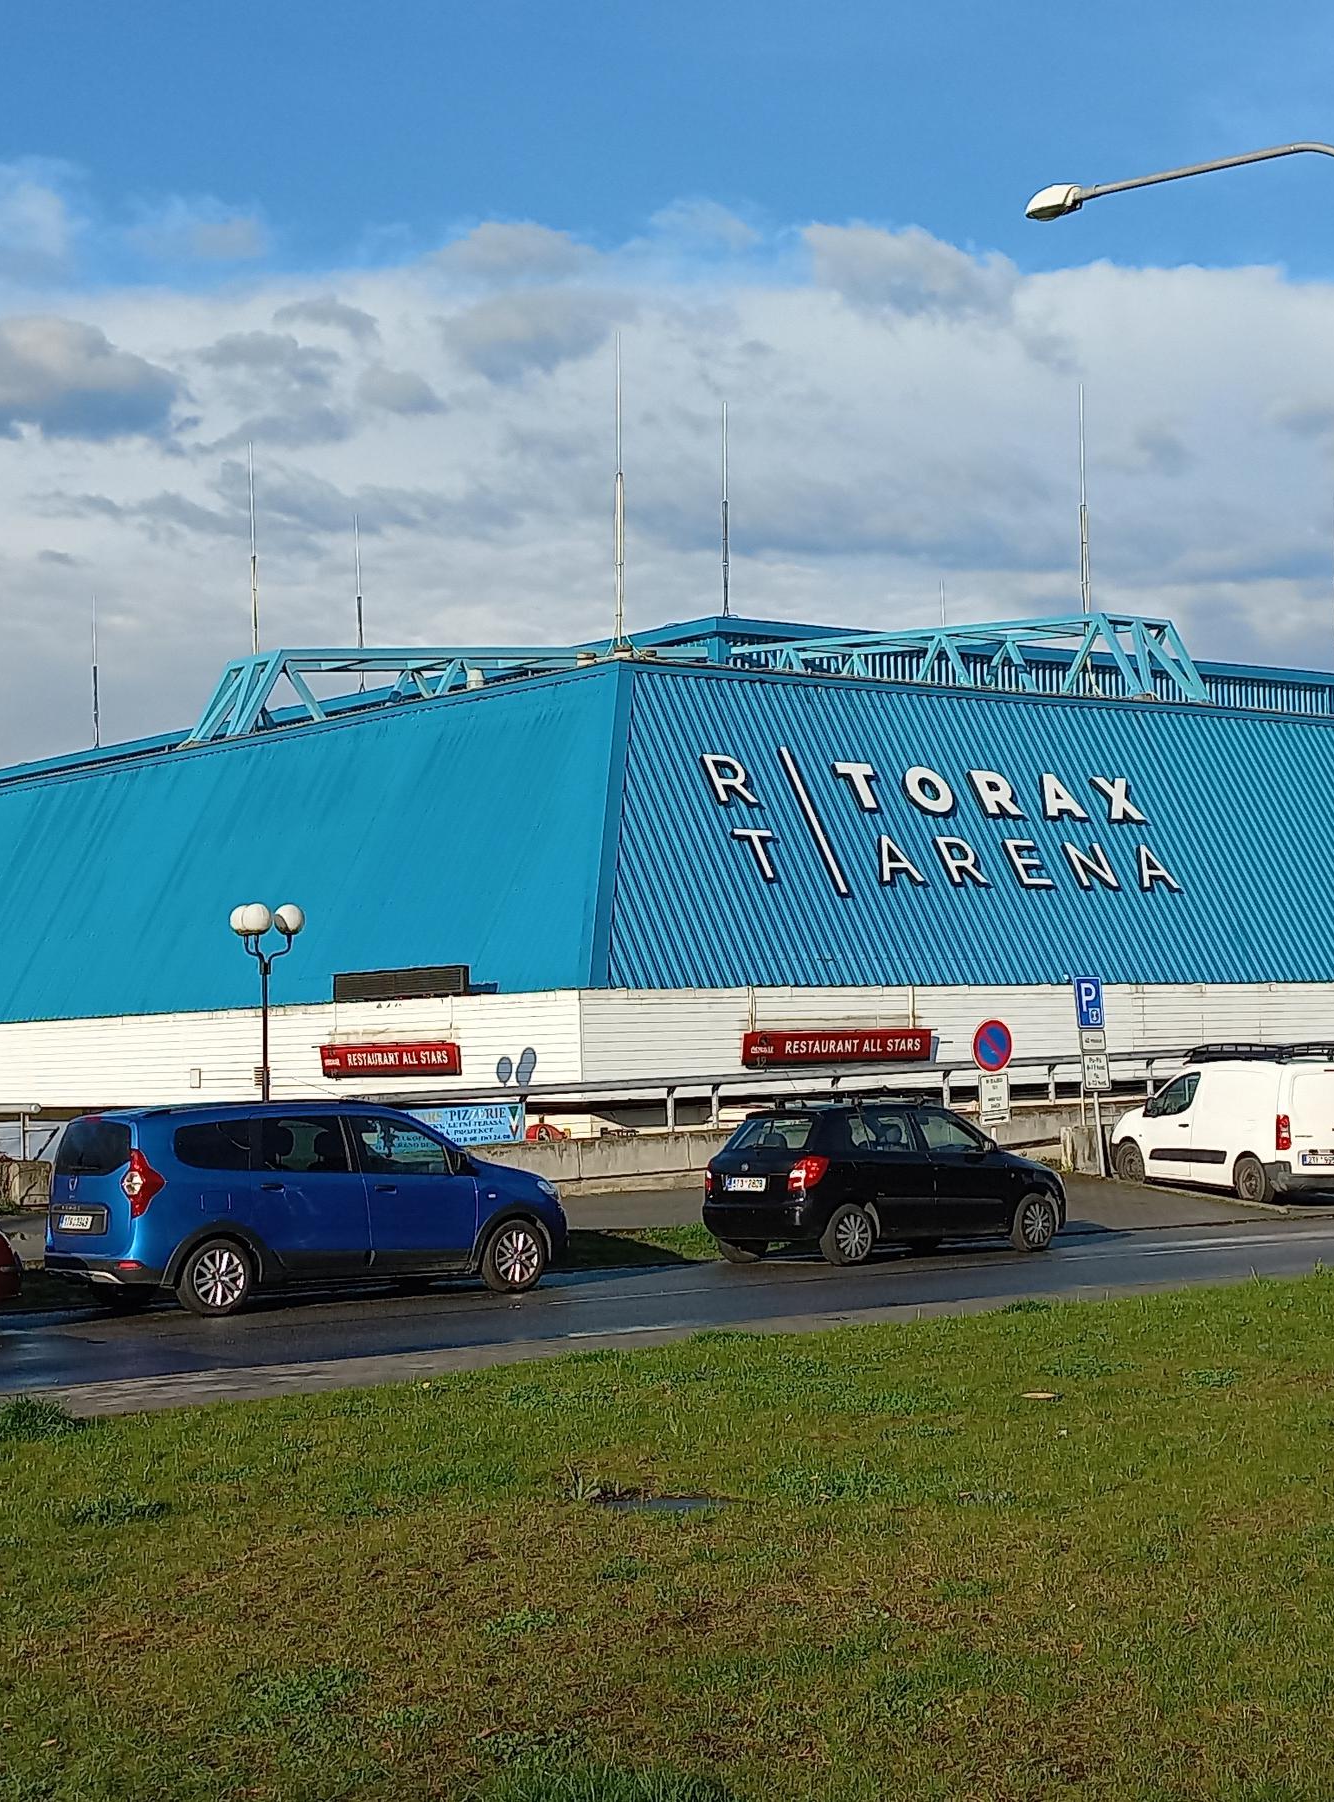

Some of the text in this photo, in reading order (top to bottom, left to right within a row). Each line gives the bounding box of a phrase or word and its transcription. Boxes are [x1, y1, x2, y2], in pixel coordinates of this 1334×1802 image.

[700, 752, 1150, 826] R TORAX
[731, 826, 1184, 894] T ARENA
[1080, 982, 1096, 1012] P
[784, 1039, 860, 1055] RESTAURANT
[862, 1039, 883, 1053] ALL
[886, 1037, 921, 1052] STARS
[346, 1052, 400, 1067] RESTAURANT
[402, 1052, 418, 1066] ALL
[420, 1050, 449, 1065] STARS
[448, 1106, 507, 1122] PIZZERIE
